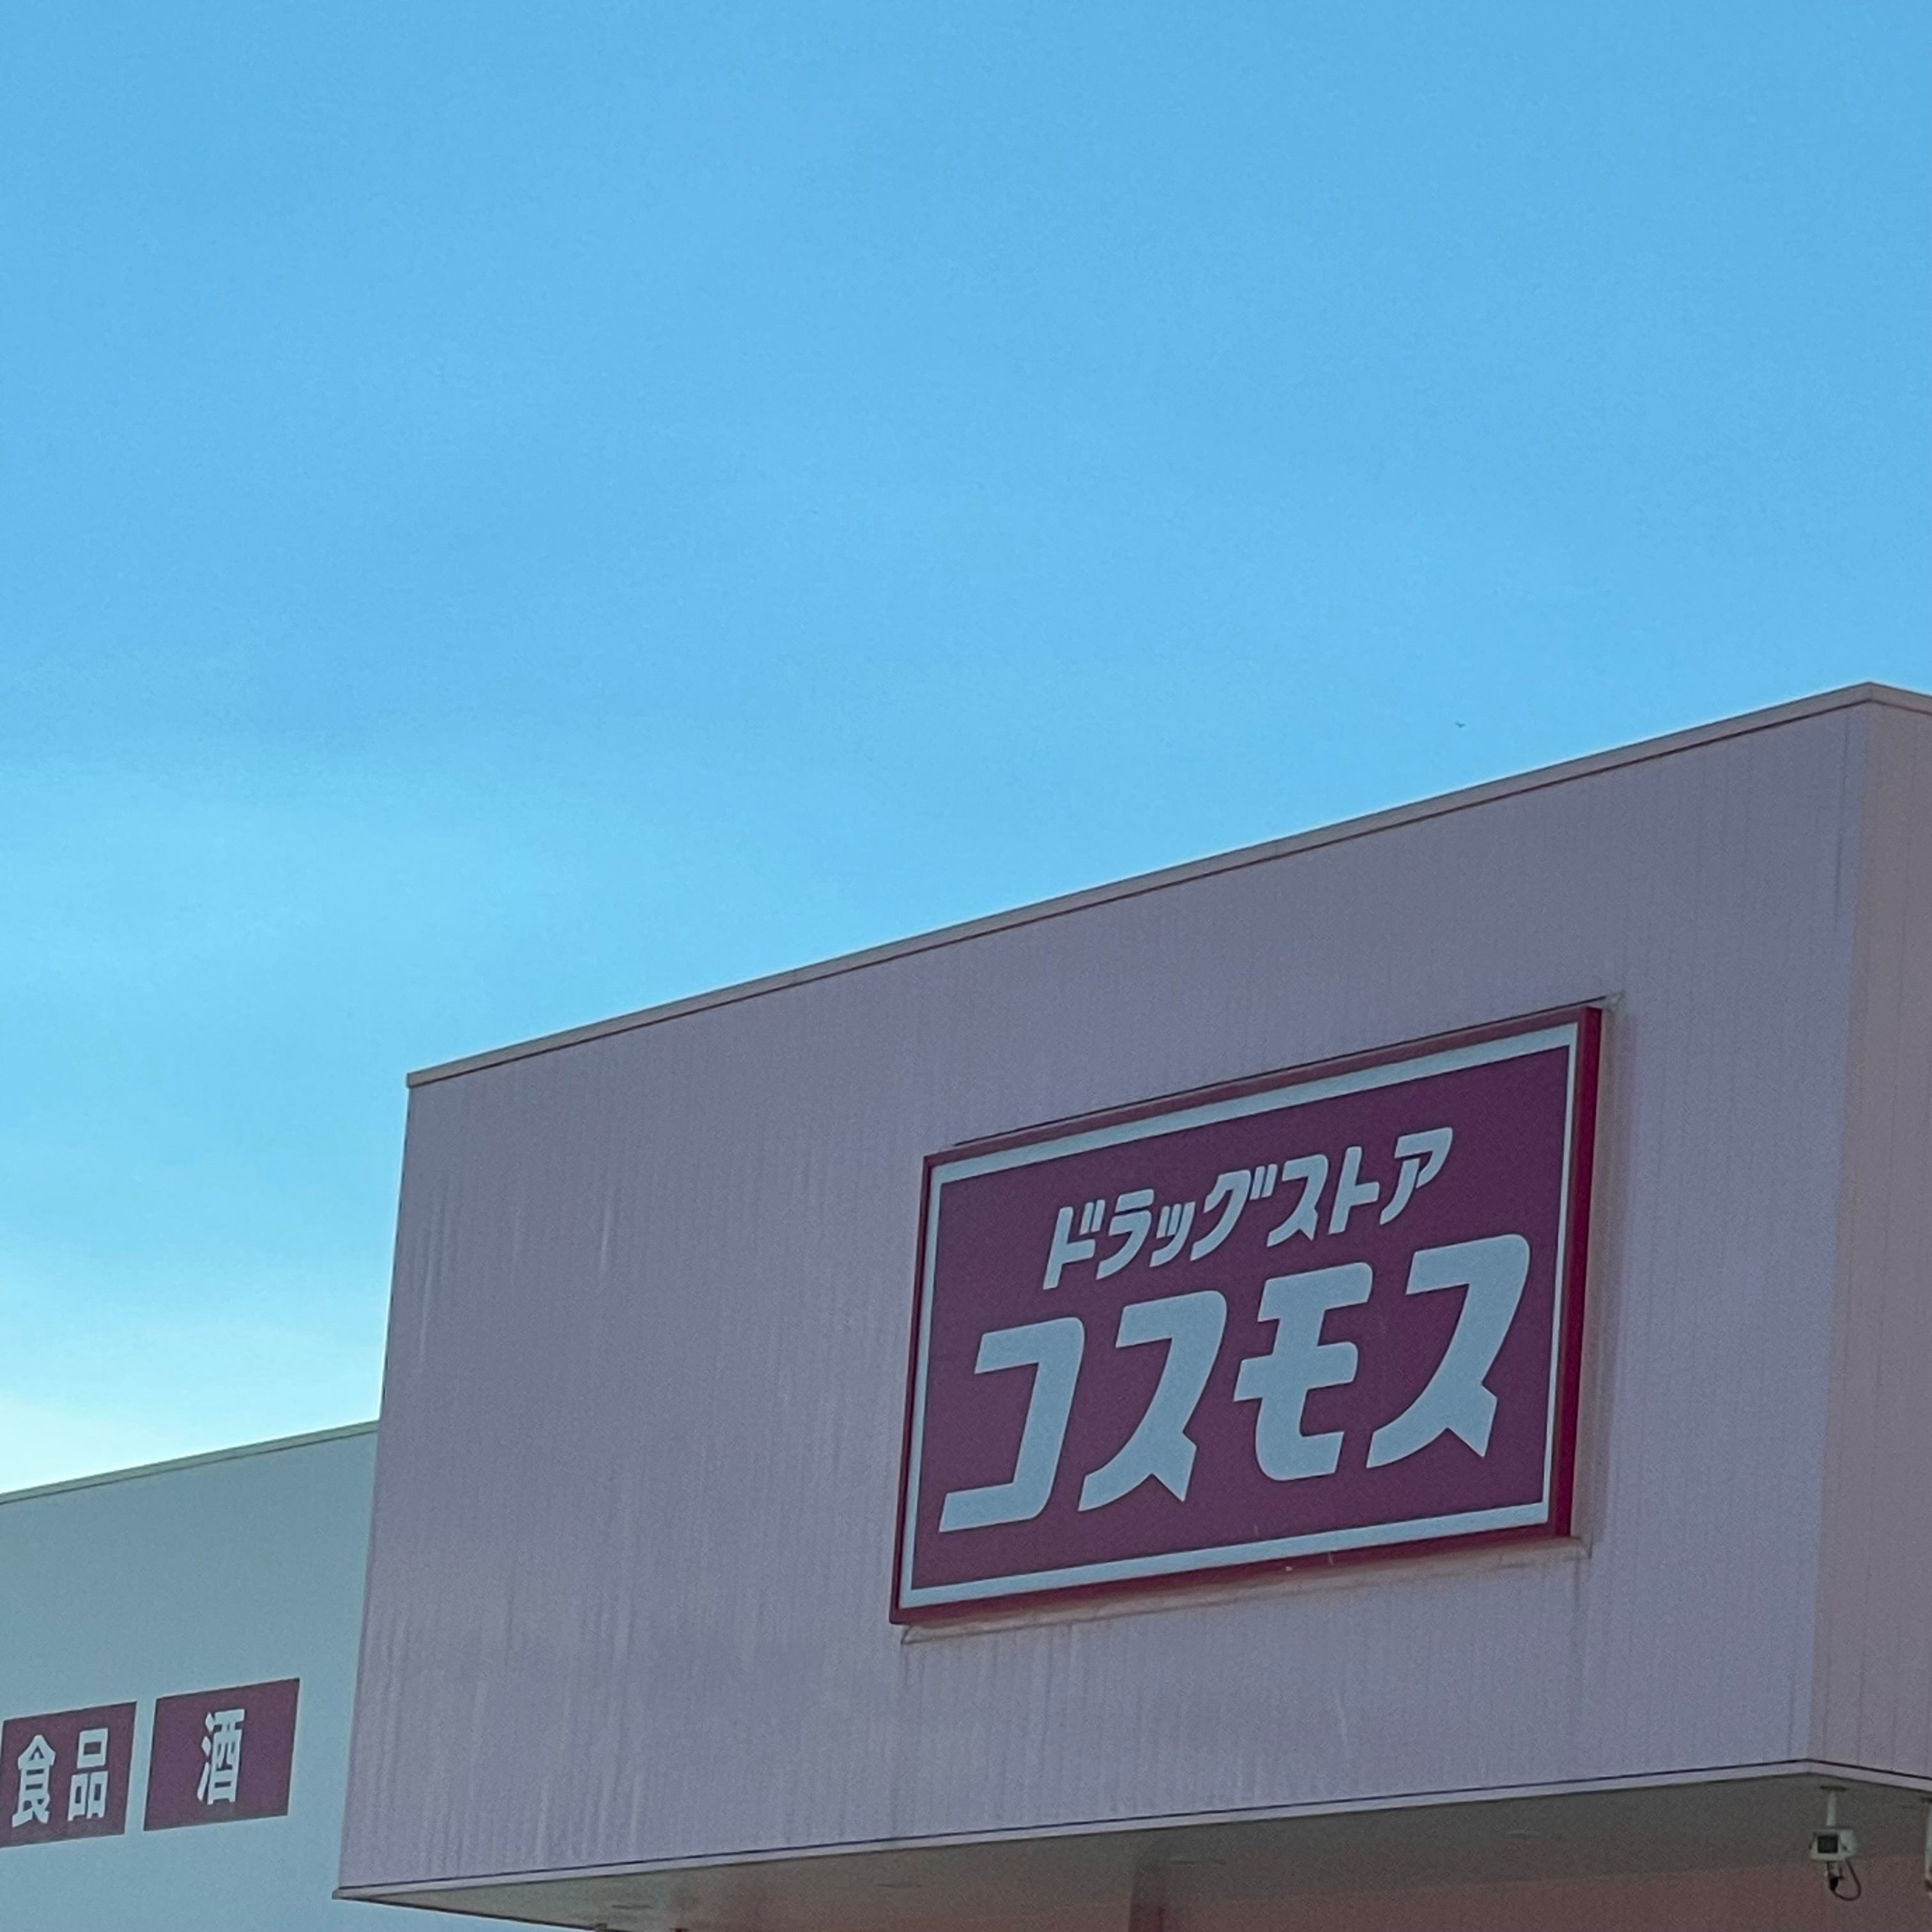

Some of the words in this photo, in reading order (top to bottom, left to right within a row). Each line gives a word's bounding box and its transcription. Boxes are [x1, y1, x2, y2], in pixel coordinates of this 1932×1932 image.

[1043, 1126, 1453, 1291] ドラッグストア
[938, 1234, 1530, 1533] コスモス
[10, 1727, 110, 1828] 食品
[196, 1708, 247, 1806] 酒
